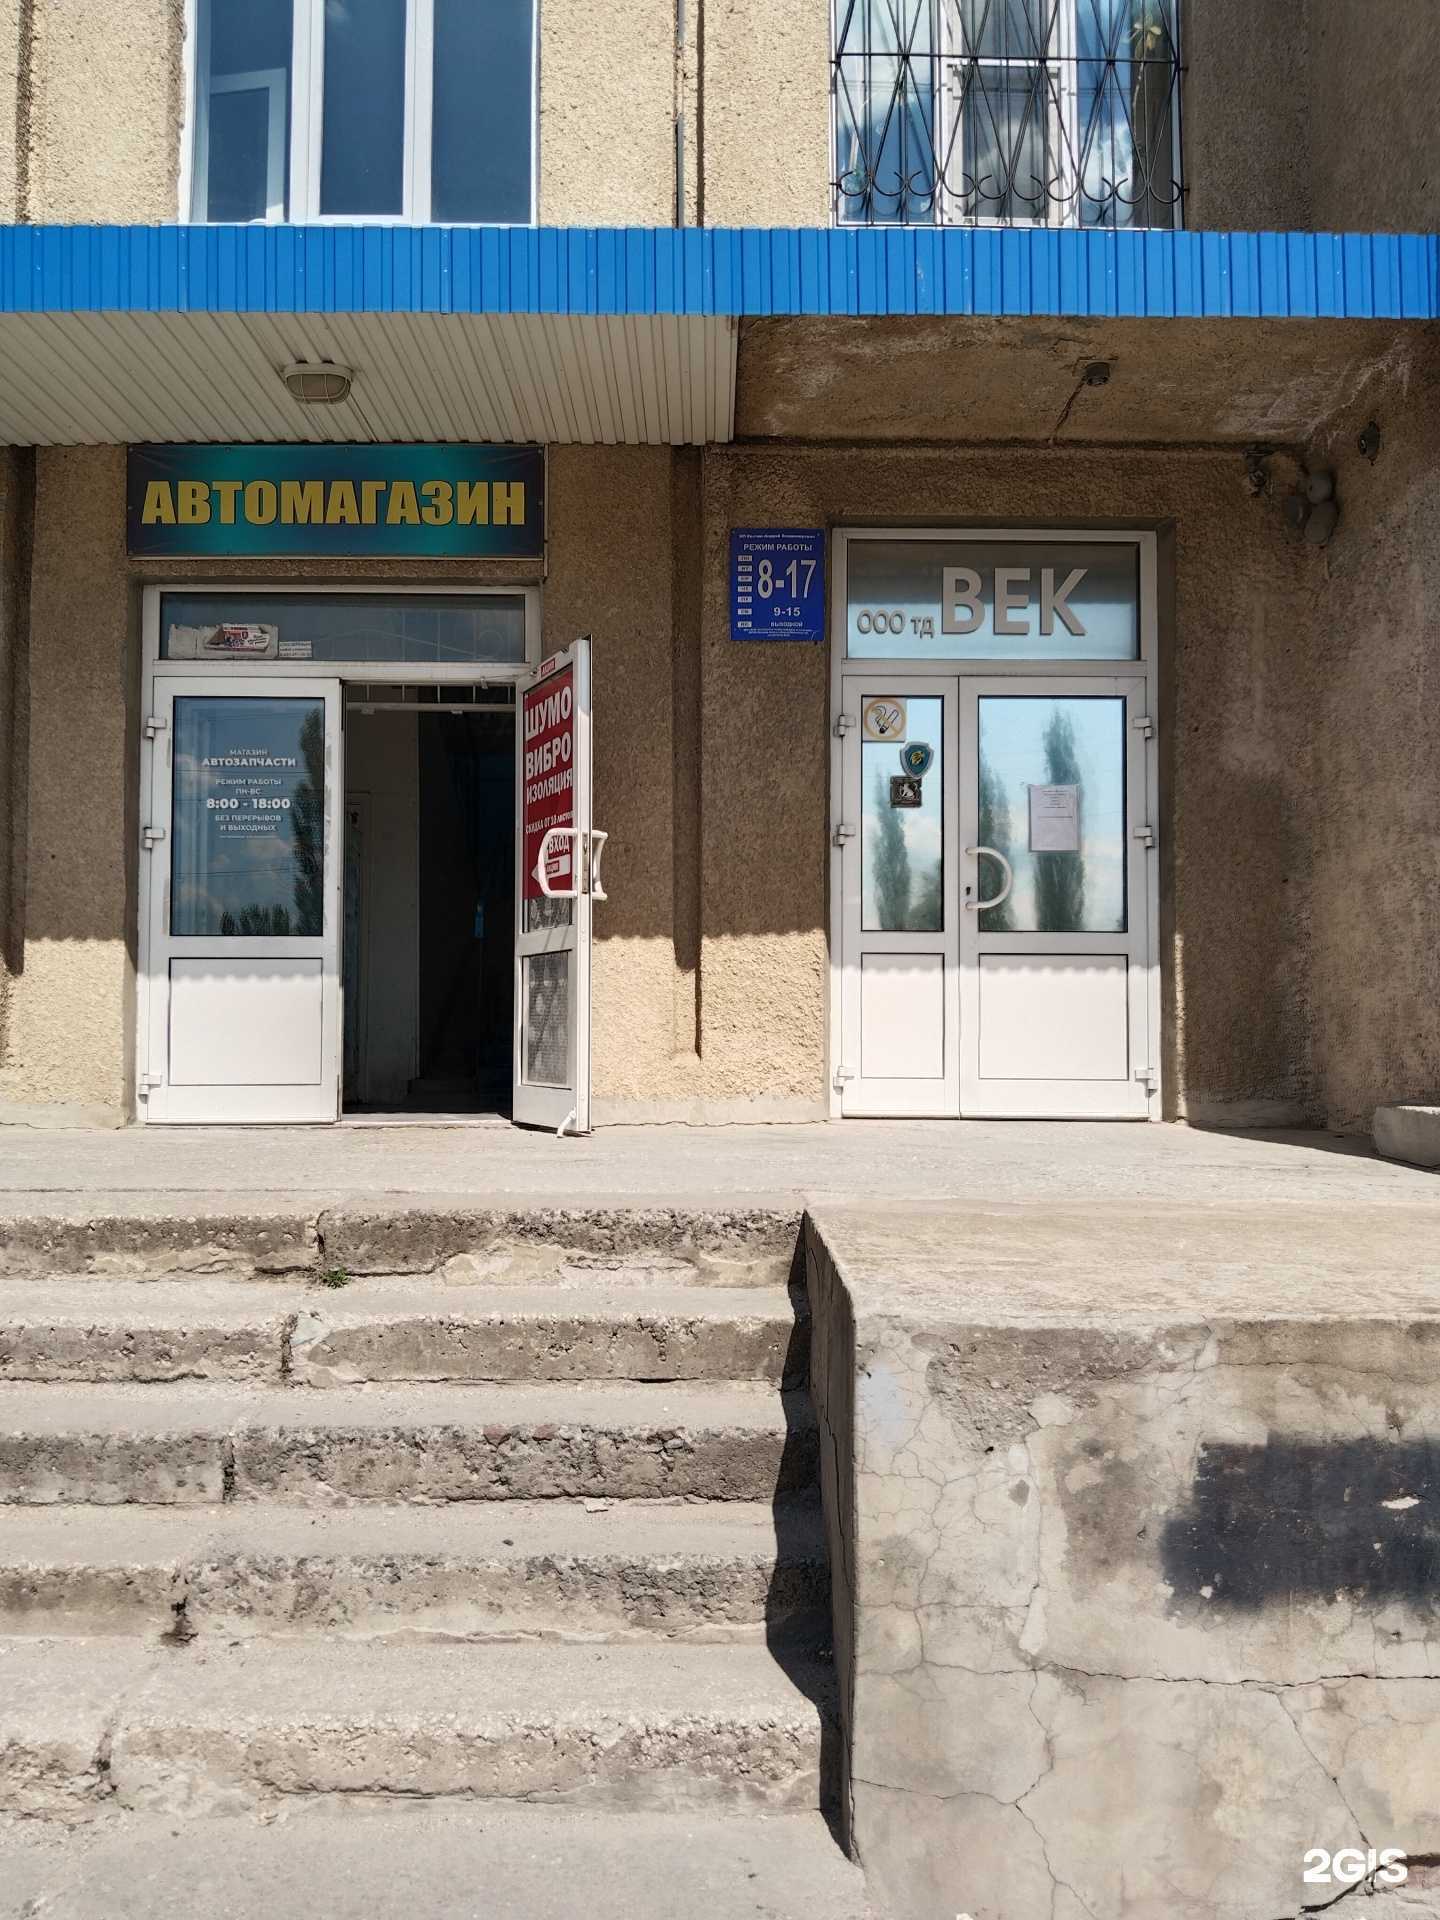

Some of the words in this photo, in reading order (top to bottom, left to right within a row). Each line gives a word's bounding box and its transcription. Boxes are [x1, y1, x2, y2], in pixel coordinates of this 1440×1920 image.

[141, 480, 525, 525] АВТОМАГАЗИН
[744, 543, 775, 551] РЕЖИМ
[776, 543, 813, 551] РАБОТЫ
[757, 559, 816, 598] 8-17
[773, 606, 800, 616] 9-15
[857, 609, 906, 634] ООО
[941, 567, 1088, 636] ВЕК
[525, 686, 572, 742] ШУМО
[202, 758, 296, 767] АВТОЗАПЧАСТИ
[525, 731, 572, 781] ВИБРО
[526, 762, 573, 805] ИЗОЛЯЦИЯ
[206, 798, 240, 809] 8:00
[251, 798, 291, 809] 18:00
[215, 814, 230, 822] БЕЗ
[231, 814, 282, 822] ПЕРЕРЫВОВ
[227, 824, 277, 832] ВЫХОДНЫХ
[548, 835, 570, 854] ВХОД
